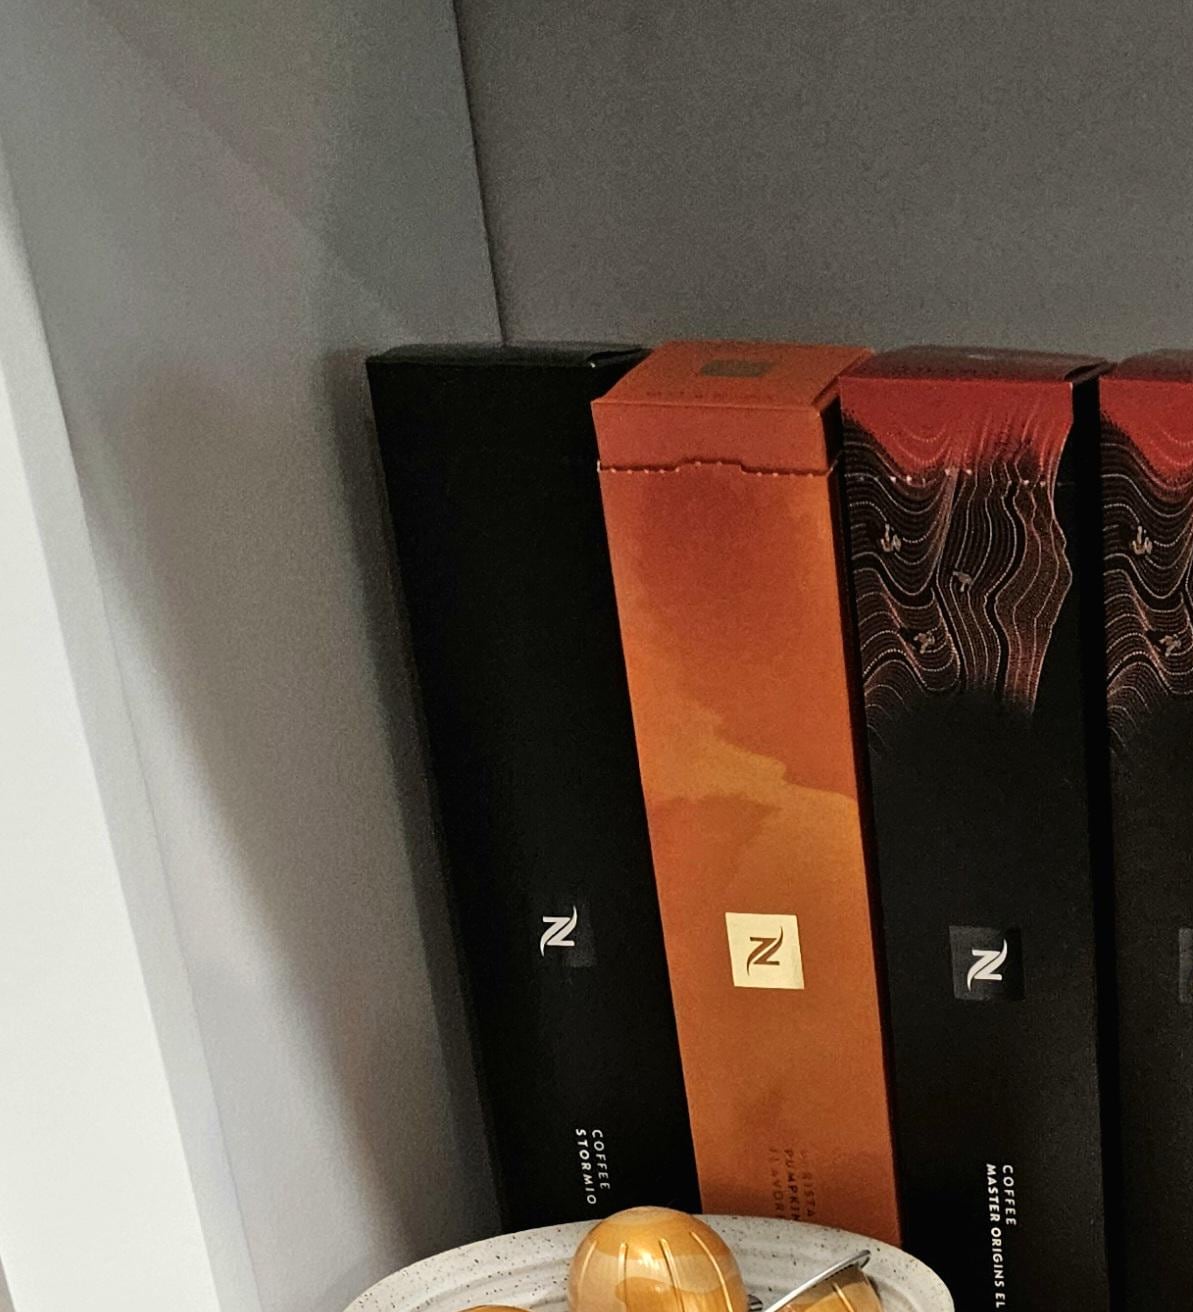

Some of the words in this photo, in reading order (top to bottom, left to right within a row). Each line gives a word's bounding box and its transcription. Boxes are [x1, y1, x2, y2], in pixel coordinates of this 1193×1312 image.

[575, 1128, 597, 1205] STORMIO
[591, 1128, 611, 1190] COFFEE
[986, 1163, 1001, 1222] MASTER
[1002, 1164, 1017, 1225] COFFEE
[990, 1226, 1005, 1288] ORIGINS
[995, 1292, 1007, 1309] EL
